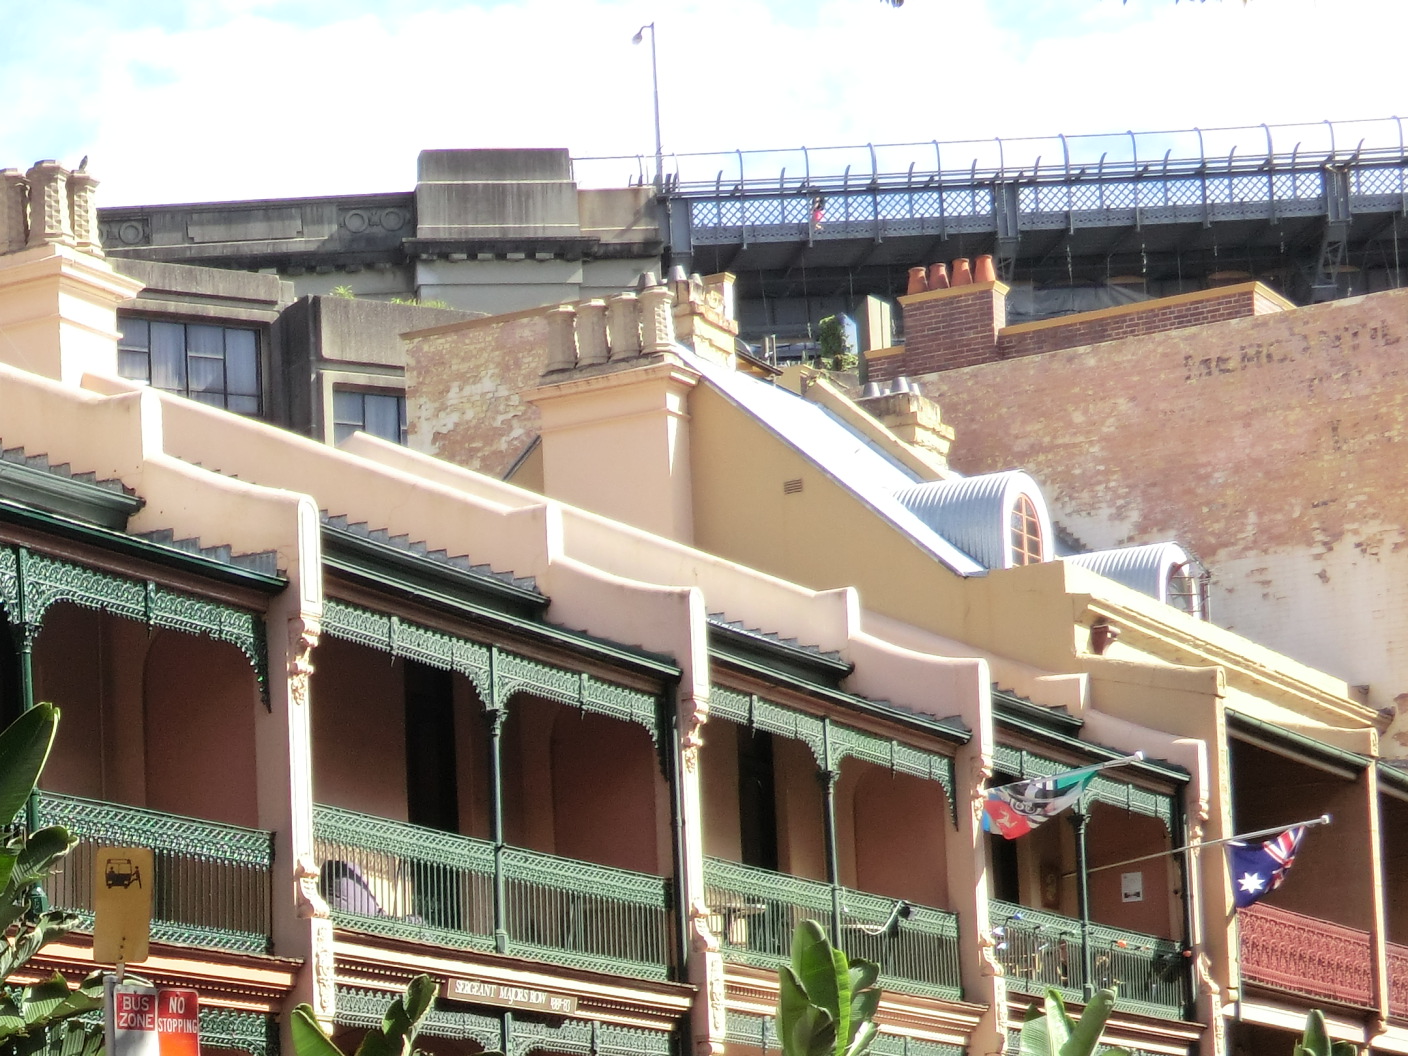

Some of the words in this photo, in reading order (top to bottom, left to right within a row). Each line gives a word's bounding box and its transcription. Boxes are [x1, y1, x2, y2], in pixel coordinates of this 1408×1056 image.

[455, 980, 497, 998] SERGEANT
[499, 987, 529, 1004] MAJORS
[529, 990, 547, 1004] ROW
[122, 996, 149, 1011] BUS
[169, 997, 185, 1014] NO
[119, 1013, 154, 1028] ZONE
[158, 1018, 197, 1033] STOPPING
